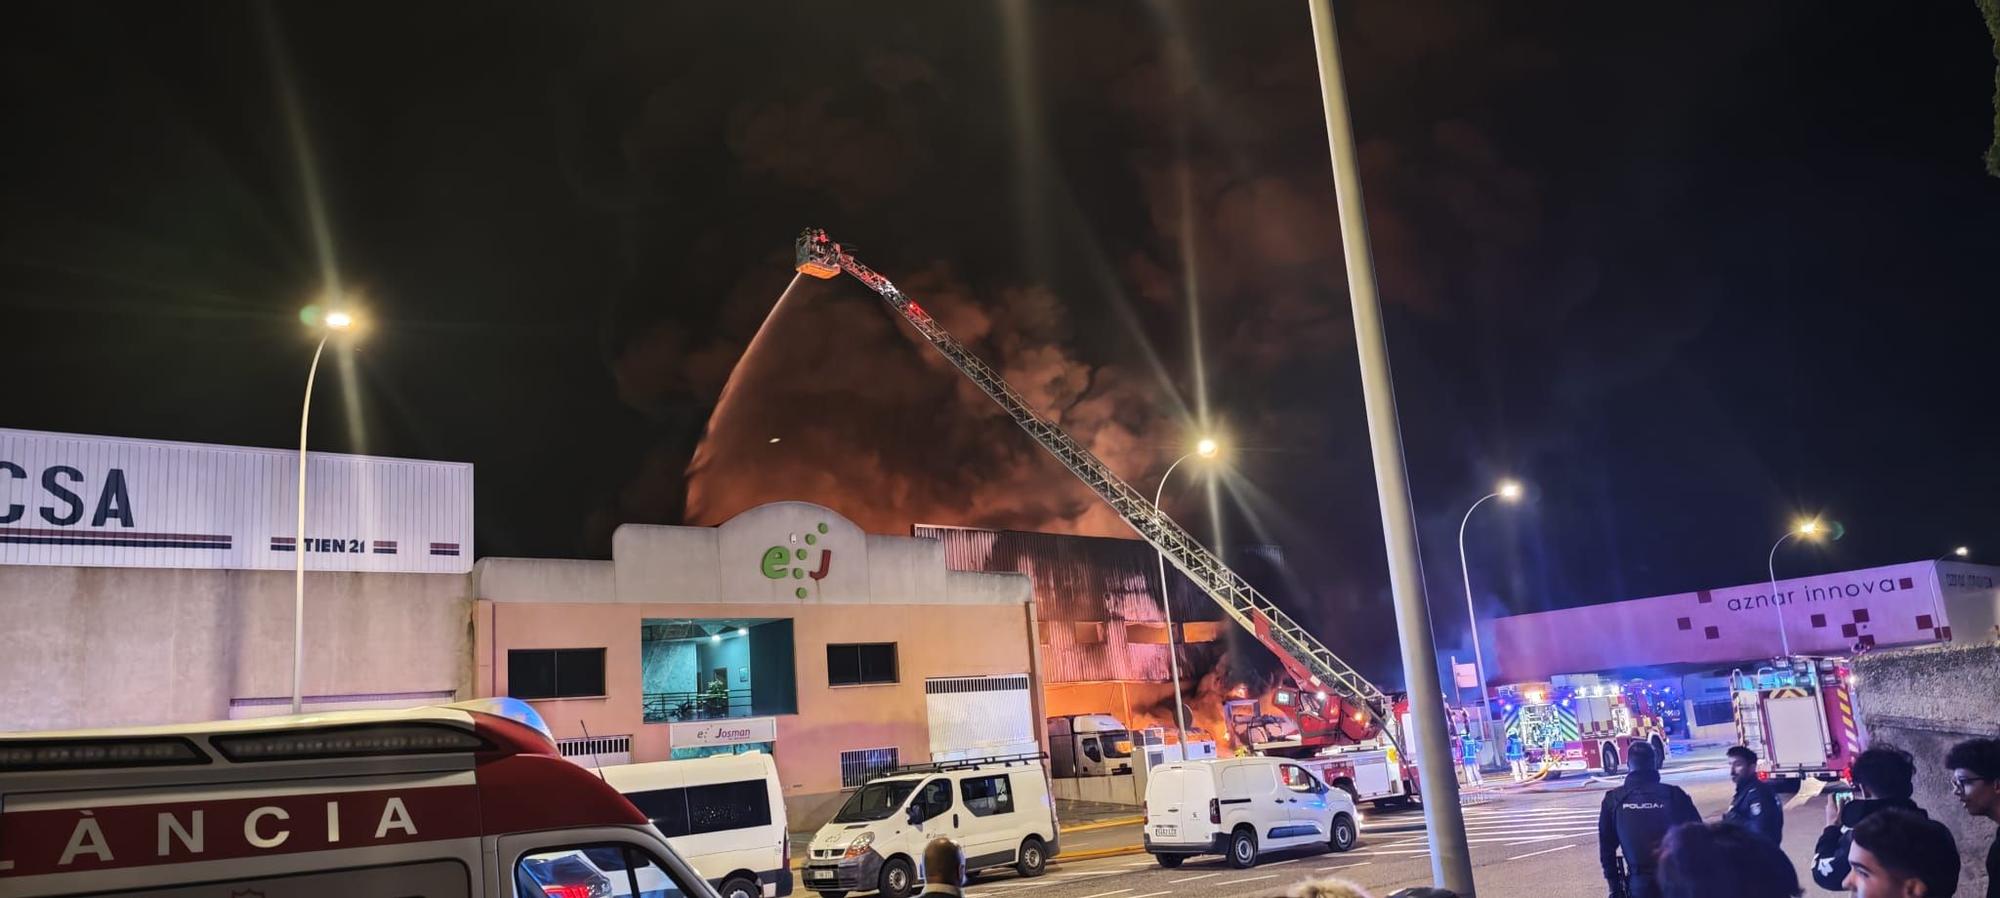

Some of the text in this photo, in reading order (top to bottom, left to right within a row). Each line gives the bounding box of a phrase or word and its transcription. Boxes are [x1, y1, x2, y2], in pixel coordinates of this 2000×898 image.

[0, 460, 135, 528] CSA
[303, 538, 365, 554] TIEN 21
[1727, 577, 1897, 612] aznar innova
[715, 727, 751, 739] Josman
[0, 796, 418, 870] ÀNCIA
